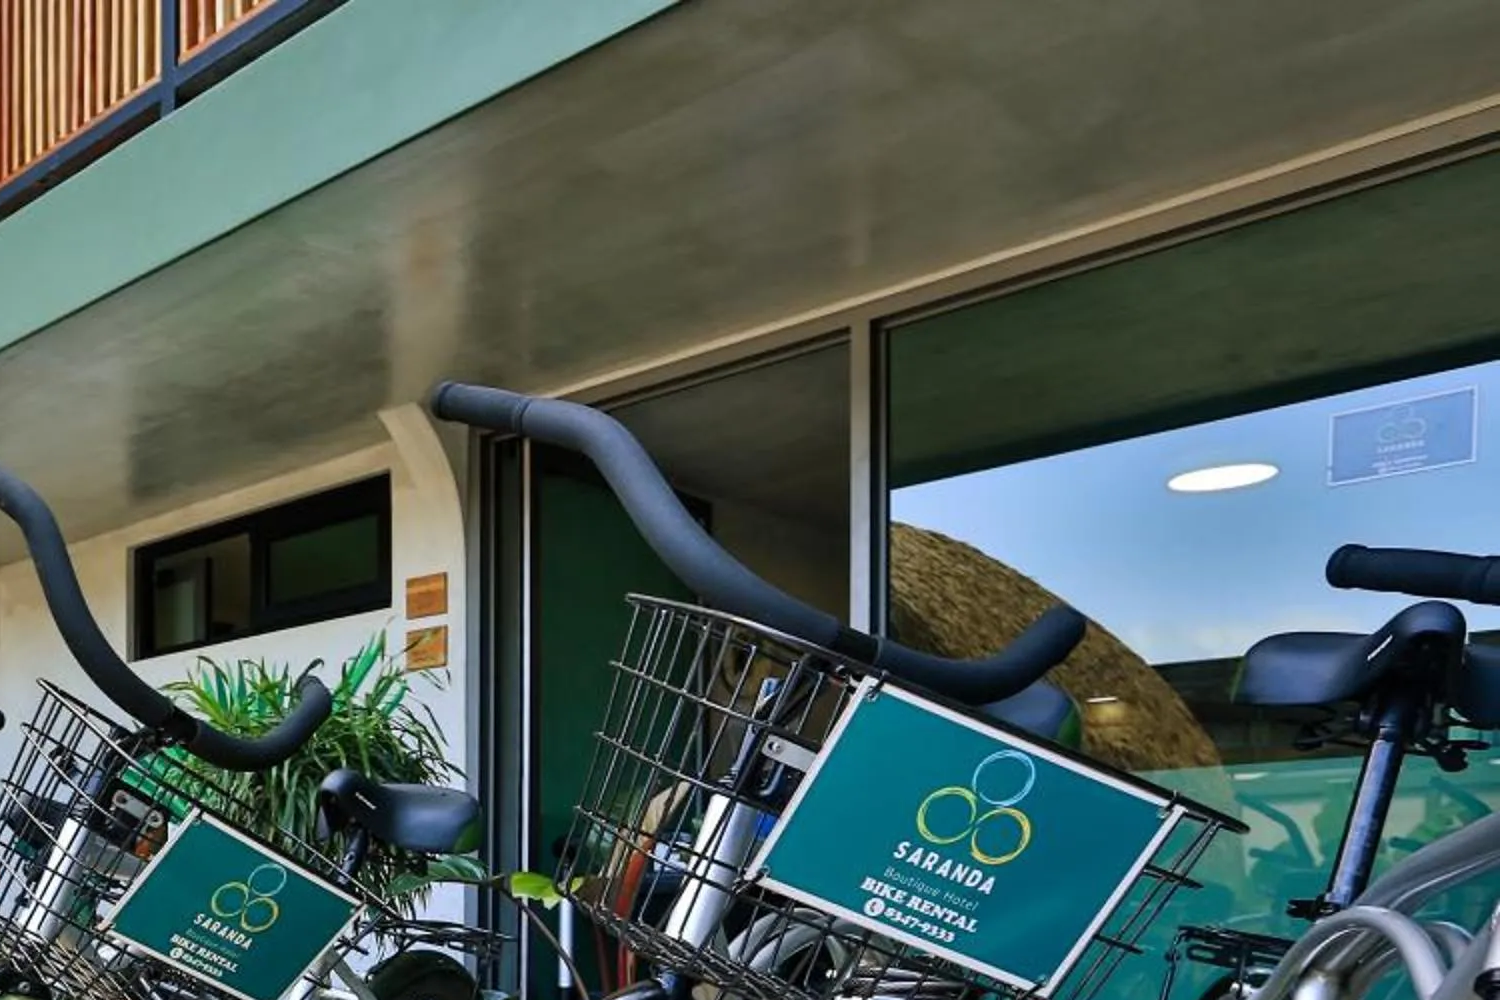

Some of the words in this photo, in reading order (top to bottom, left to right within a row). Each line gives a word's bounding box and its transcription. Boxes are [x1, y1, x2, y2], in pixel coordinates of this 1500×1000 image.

[883, 865, 940, 897] Boutique
[943, 891, 979, 911] Hotel
[893, 841, 996, 895] SARANDA
[860, 876, 908, 904] BIKE
[906, 895, 979, 933] RENTAL
[170, 933, 199, 953] BIKE
[196, 947, 238, 973] RENTAL
[193, 913, 253, 950] SARANDA
